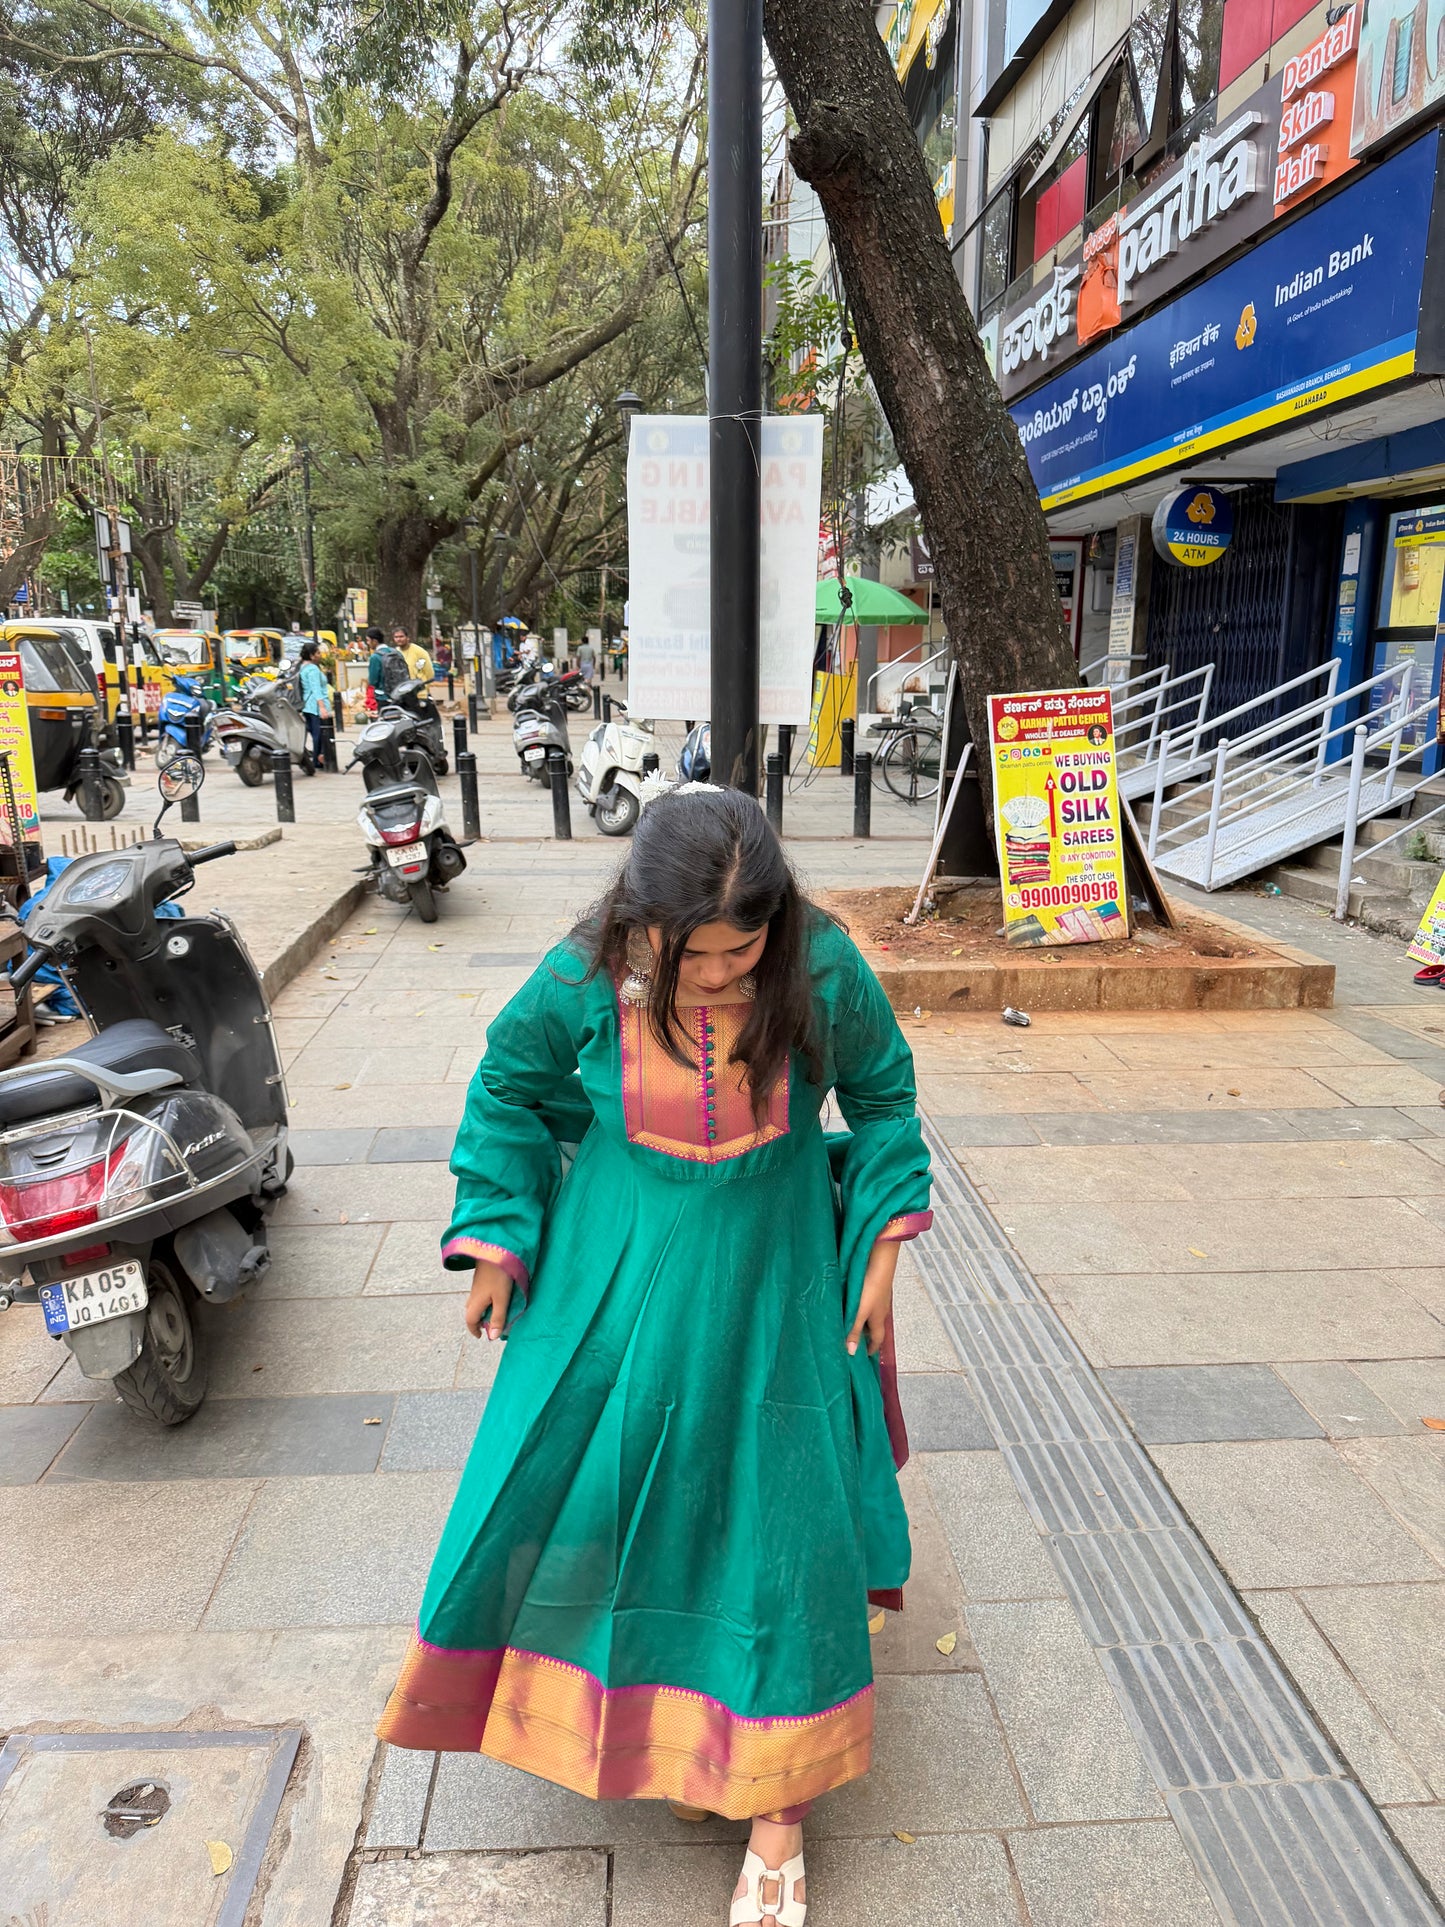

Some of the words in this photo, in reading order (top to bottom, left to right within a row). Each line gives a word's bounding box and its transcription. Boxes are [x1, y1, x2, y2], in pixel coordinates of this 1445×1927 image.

[1281, 3, 1356, 102] Dental
[1278, 92, 1326, 152] Skin
[1273, 144, 1320, 205] Hair
[1117, 112, 1257, 305] partha
[1275, 267, 1323, 307] Indian
[1328, 234, 1374, 278] Bank
[1304, 306, 1310, 315] of
[1310, 302, 1321, 312] India
[1321, 284, 1353, 307] Undertaking)
[1170, 335, 1202, 369] इंडियन
[1203, 323, 1221, 346] बैंक
[1324, 363, 1351, 381] BENGALURU
[1082, 355, 1137, 423] ಬ್ಯಾಂಕ್
[1294, 391, 1327, 410] ALLAHABAD
[1173, 532, 1184, 542] 24
[1186, 532, 1219, 545] HOURS
[1183, 548, 1206, 559] ATM
[1068, 694, 1106, 709] ಸೆಂಟರ್
[1053, 715, 1078, 727] PATTU
[1079, 713, 1108, 725] CENTRE
[1024, 731, 1058, 740] WHOLESLE
[1059, 728, 1085, 737] DEALERS
[1055, 756, 1071, 768] WE
[1072, 752, 1111, 766] BUYING
[1060, 769, 1108, 793] OLD
[1061, 797, 1110, 823] SILK
[1063, 828, 1115, 846] SAREES
[1067, 853, 1080, 862] ANY
[1081, 850, 1116, 861] CONDITION
[1084, 863, 1093, 871] ON
[1066, 875, 1078, 883] THE
[1079, 874, 1096, 882] SPOT
[1097, 872, 1115, 881] CASH
[1020, 881, 1118, 909] 9900090918
[65, 1278, 94, 1303] KA
[98, 1268, 126, 1293] 05
[50, 1314, 65, 1324] IND
[72, 1306, 91, 1325] JQ
